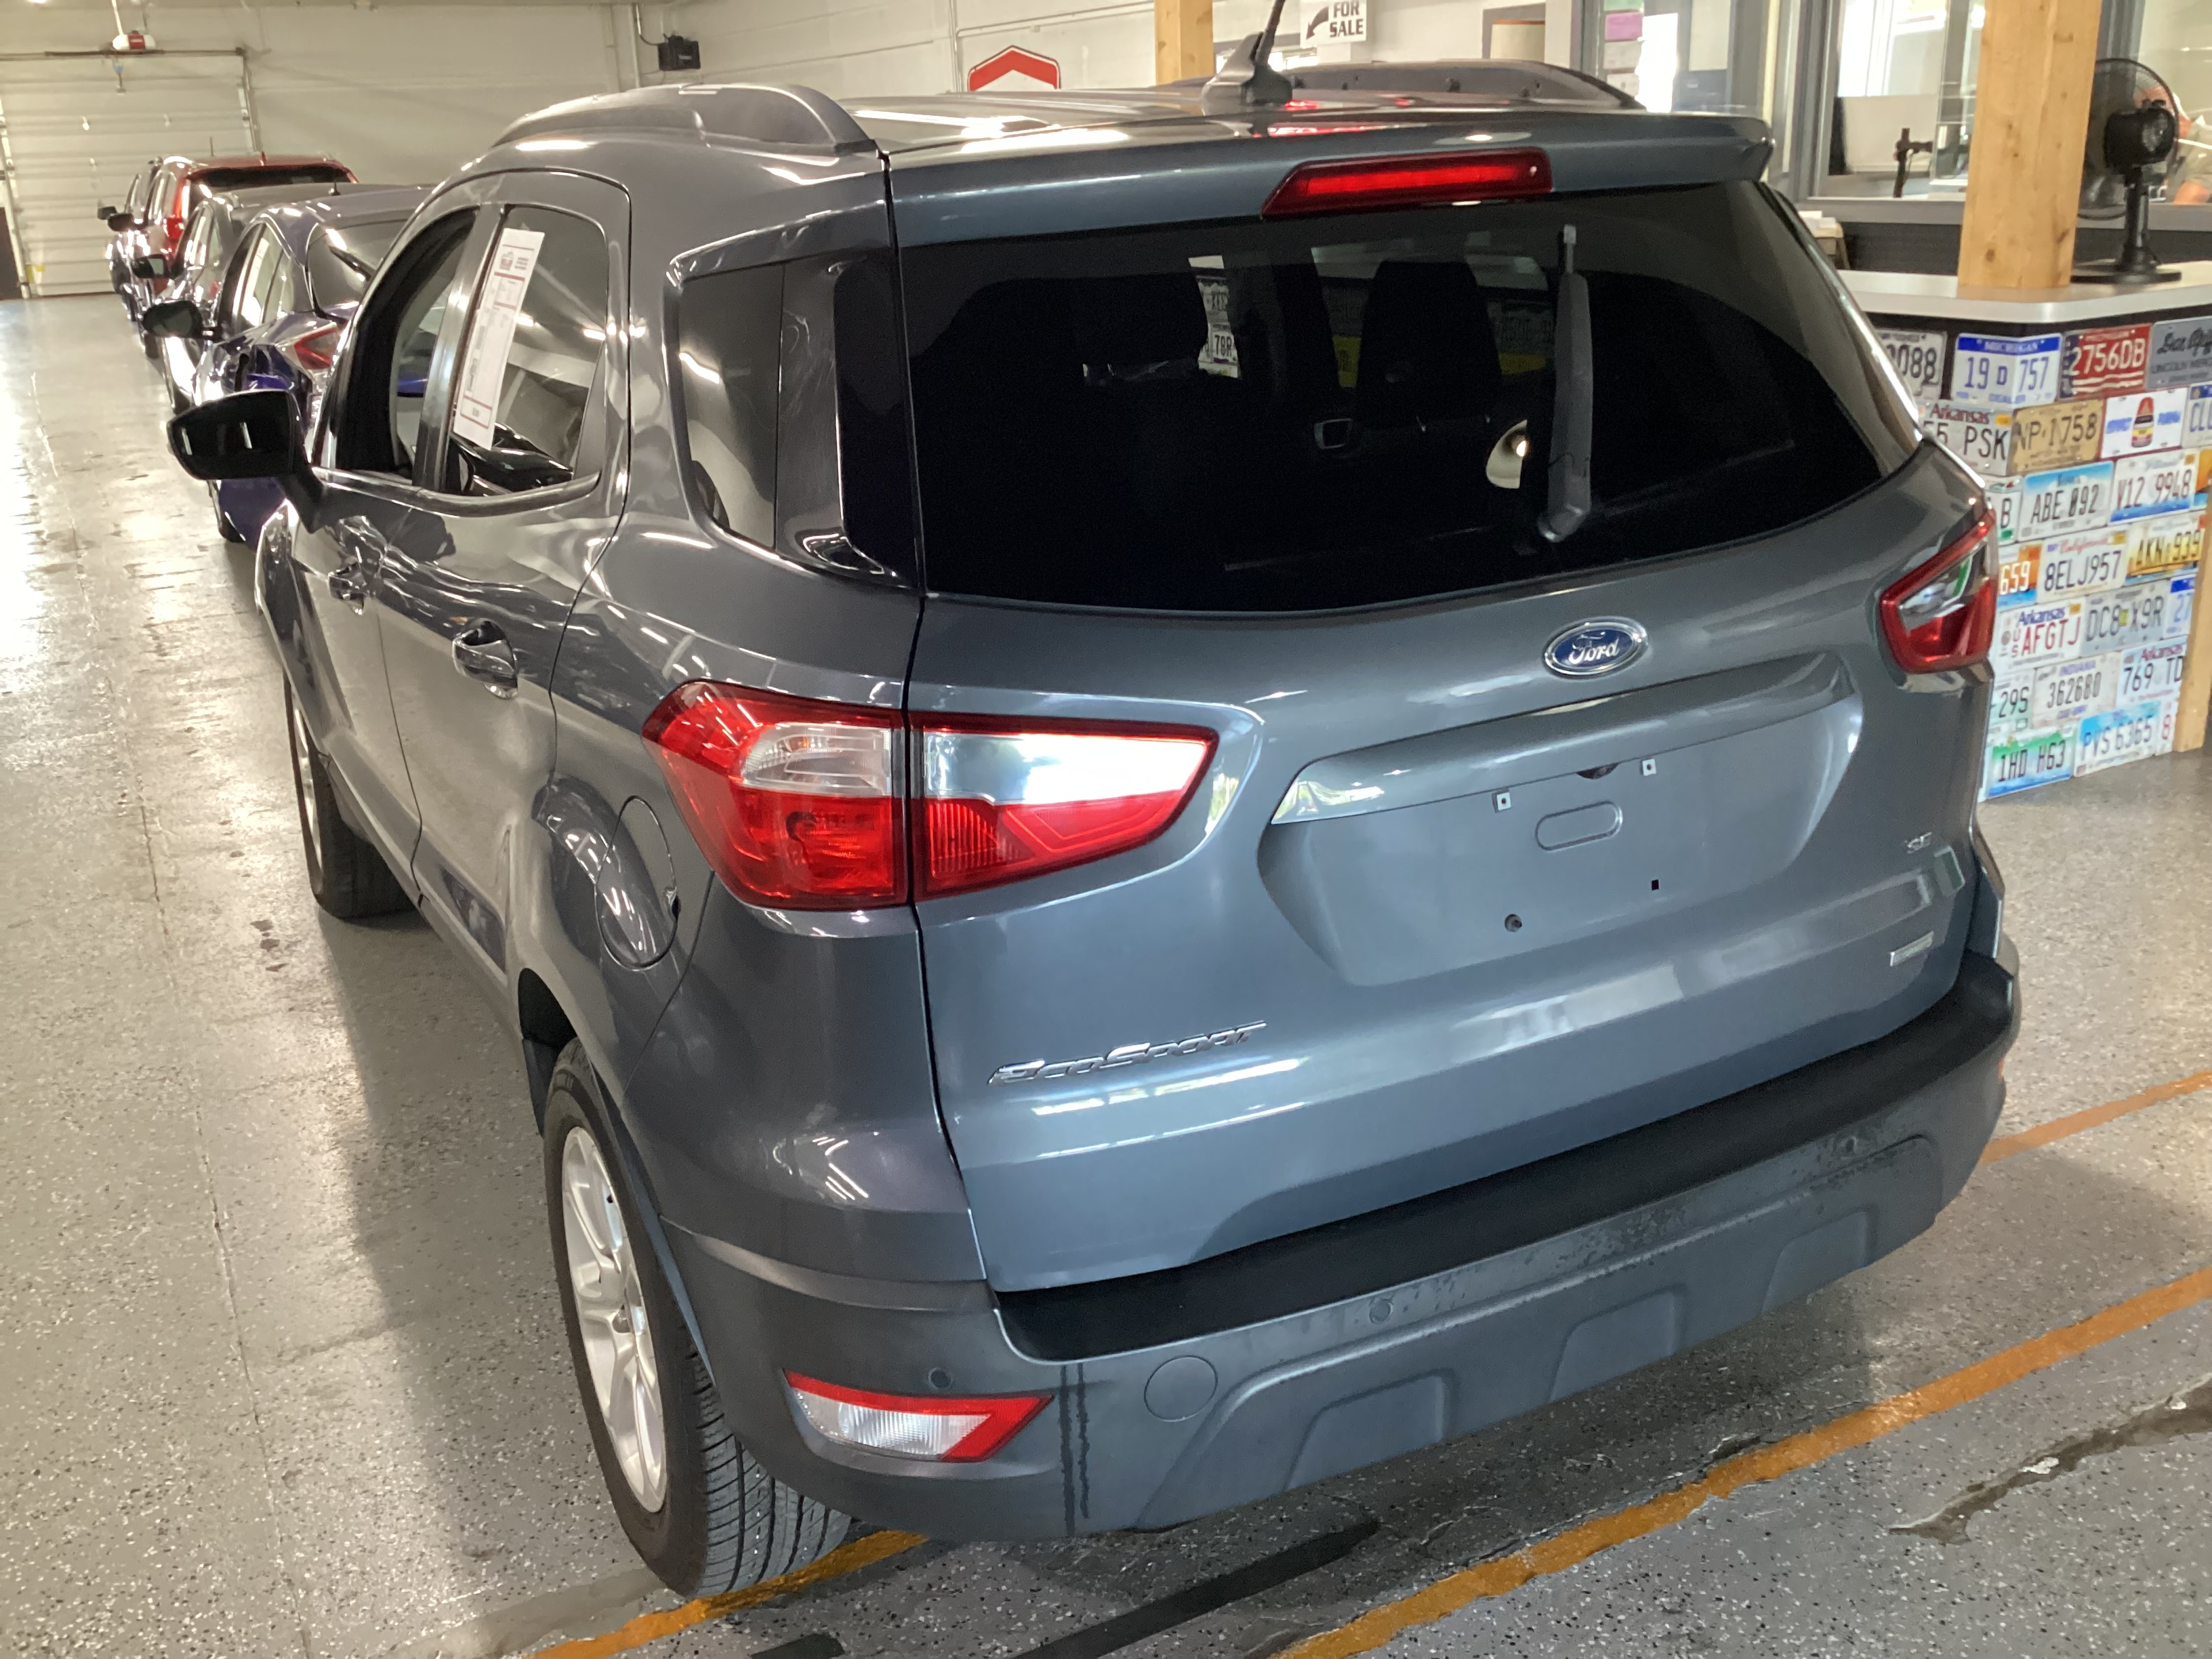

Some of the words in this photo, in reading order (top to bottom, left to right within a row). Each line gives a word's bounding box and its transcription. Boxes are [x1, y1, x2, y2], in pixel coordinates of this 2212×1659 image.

[1333, 0, 1359, 18] FOR
[1330, 19, 1364, 37] SALE
[1964, 356, 1990, 389] 19
[2018, 356, 2049, 392] 757
[1963, 425, 2009, 461] PSK
[2030, 493, 2064, 524] ABE
[2045, 550, 2122, 592] 8ELJ957
[1569, 631, 1620, 664] Ford
[2021, 616, 2081, 656] AFGTJ
[2124, 662, 2154, 695] 769
[987, 1020, 1267, 1086] EcoSport
